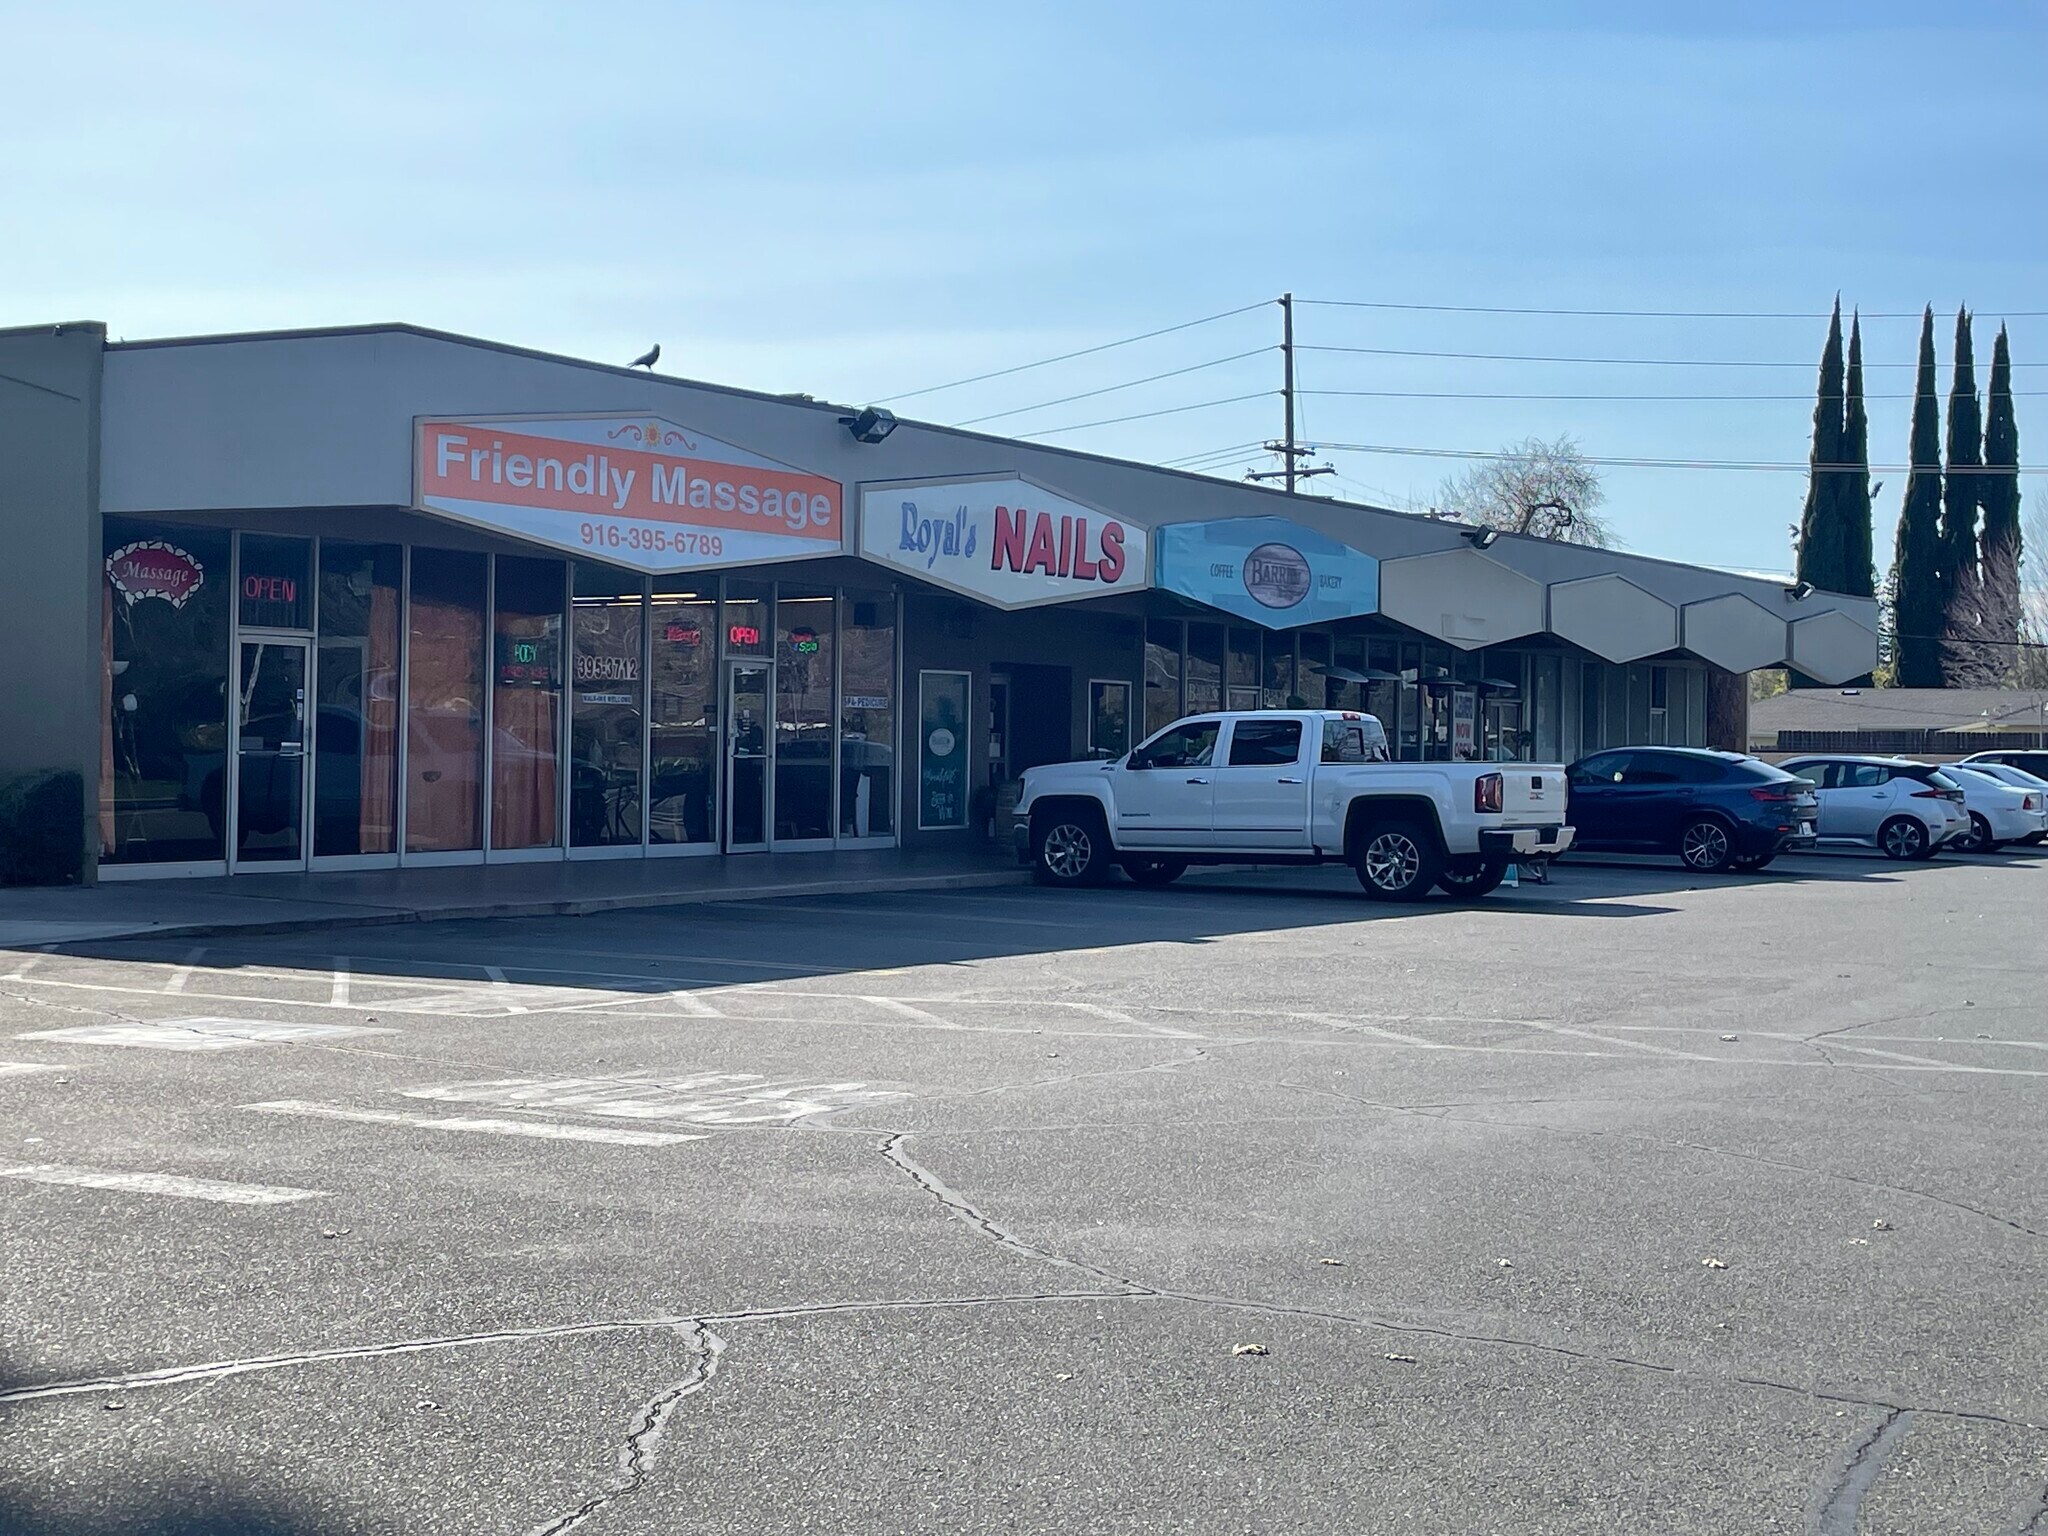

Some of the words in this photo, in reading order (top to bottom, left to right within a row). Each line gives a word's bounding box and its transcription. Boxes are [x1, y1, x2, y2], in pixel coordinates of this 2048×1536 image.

[436, 433, 635, 510] Friendly
[651, 463, 832, 530] Massage
[580, 522, 723, 556] 916-395-6789
[899, 501, 977, 569] Royal's
[991, 505, 1126, 583] NAILS
[122, 560, 189, 588] Massage
[1210, 563, 1234, 579] COFFEE
[1319, 574, 1343, 590] BAKERY
[245, 575, 296, 602] OPEN
[729, 624, 760, 646] OPEN
[577, 655, 638, 680] 395-3712
